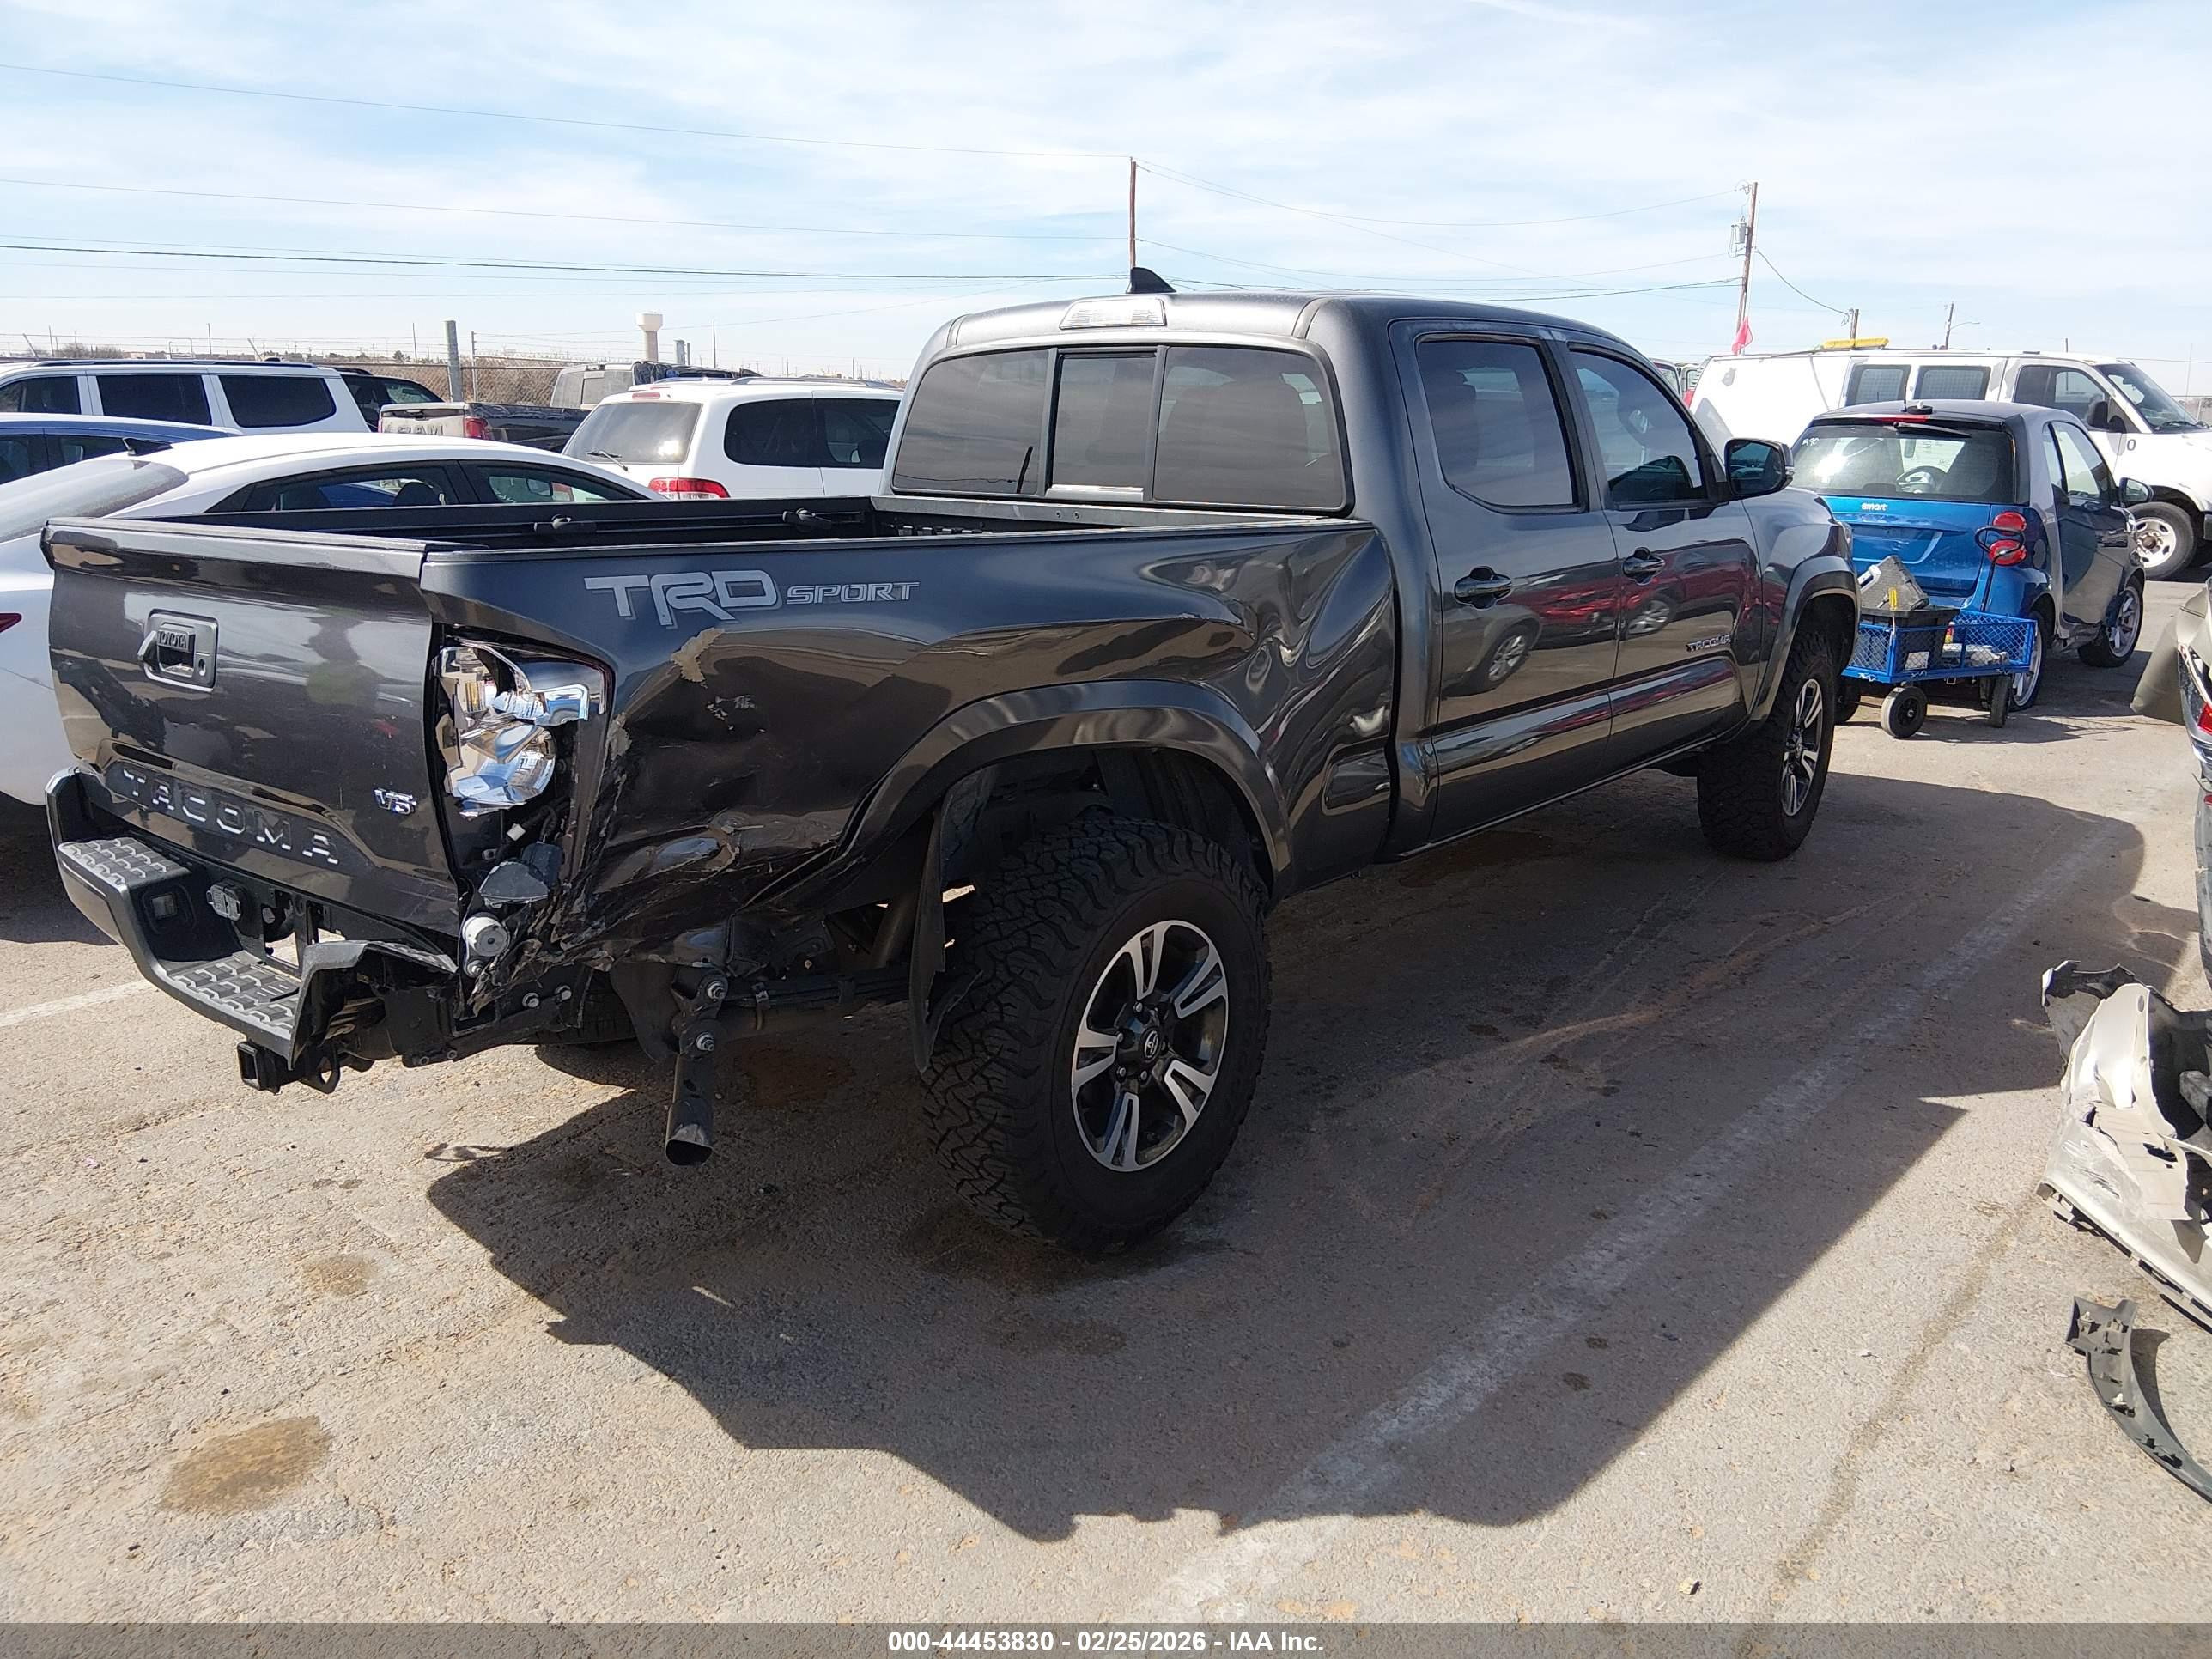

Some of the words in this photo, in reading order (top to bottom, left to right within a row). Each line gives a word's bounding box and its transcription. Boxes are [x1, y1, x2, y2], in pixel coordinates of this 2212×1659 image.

[1861, 502, 1888, 512] smart
[584, 569, 781, 628] TRD
[786, 581, 921, 605] SPORT
[157, 630, 188, 649] TOYOTA
[1685, 634, 1732, 653] TACOMA
[374, 787, 418, 816] V6
[122, 769, 340, 866] TACOMA
